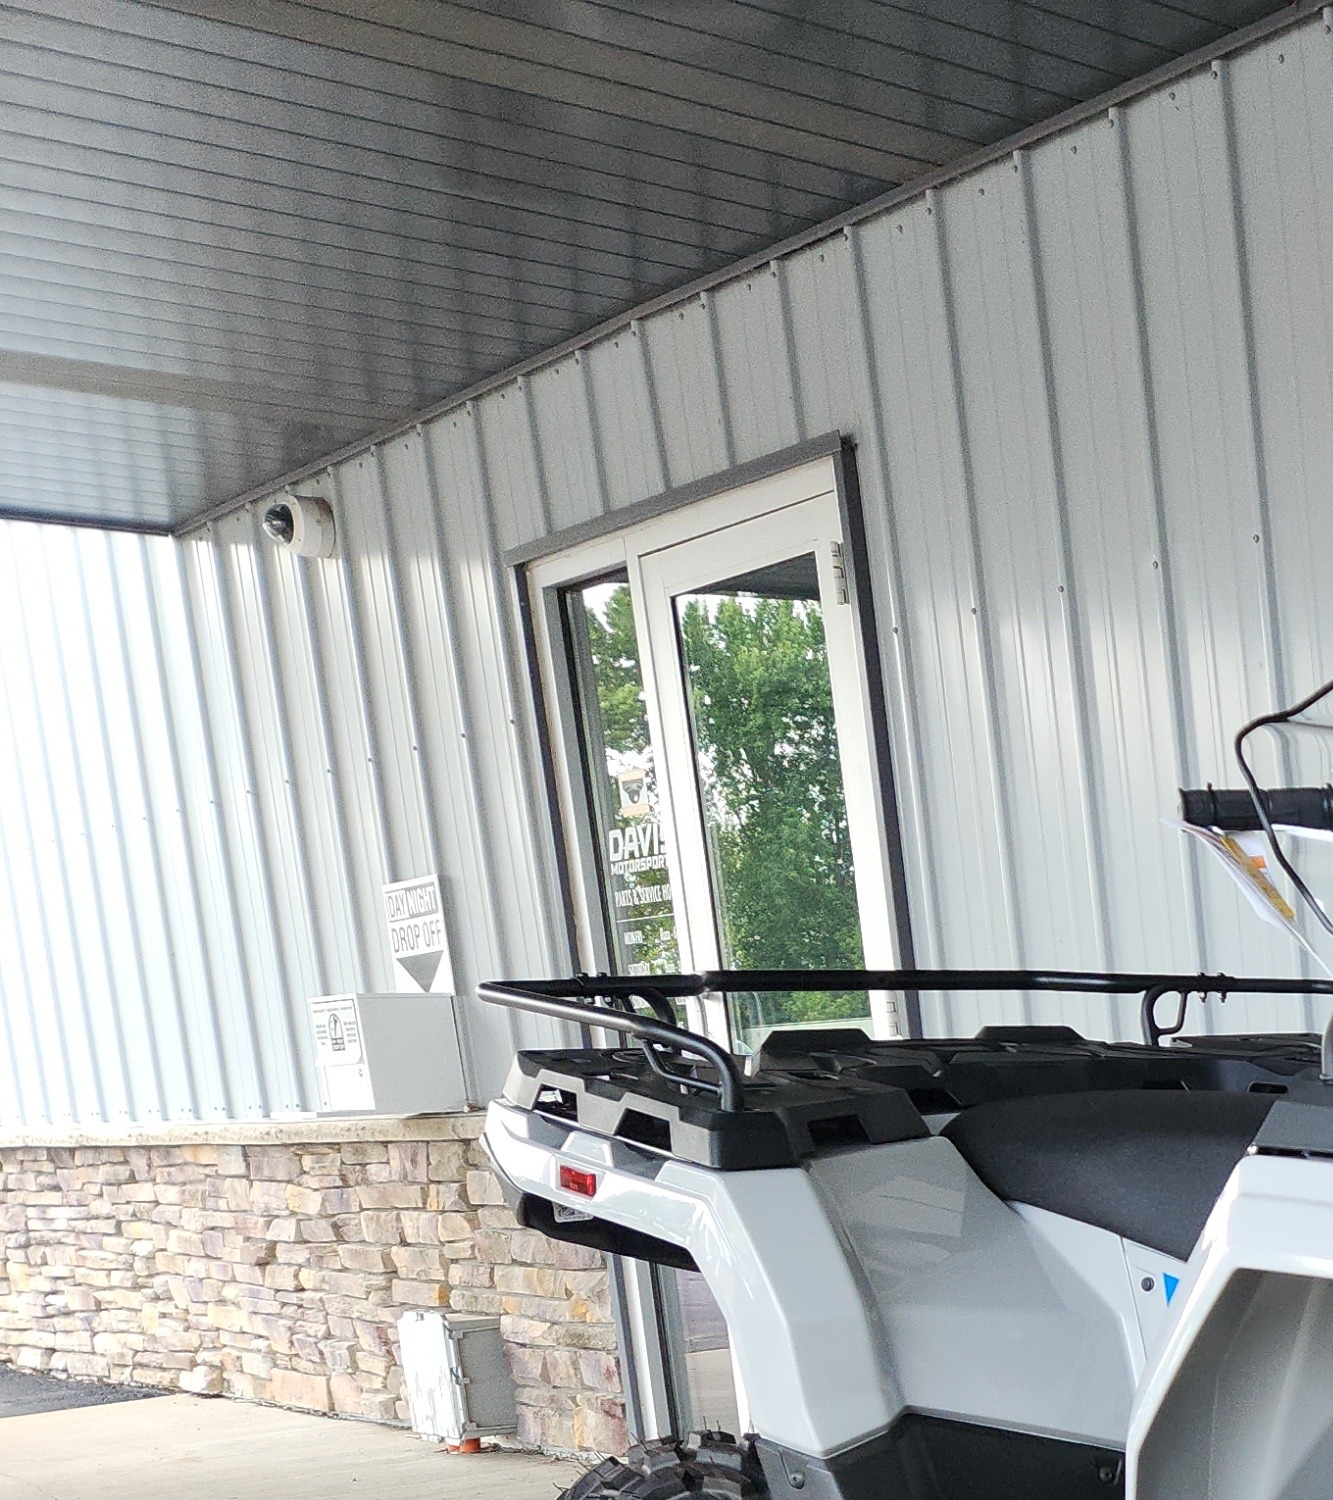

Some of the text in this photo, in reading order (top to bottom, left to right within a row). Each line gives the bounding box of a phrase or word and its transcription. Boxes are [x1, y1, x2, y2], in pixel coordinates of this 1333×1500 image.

[387, 885, 437, 918] DAY NIGHT
[391, 919, 442, 953] DROP OFF
